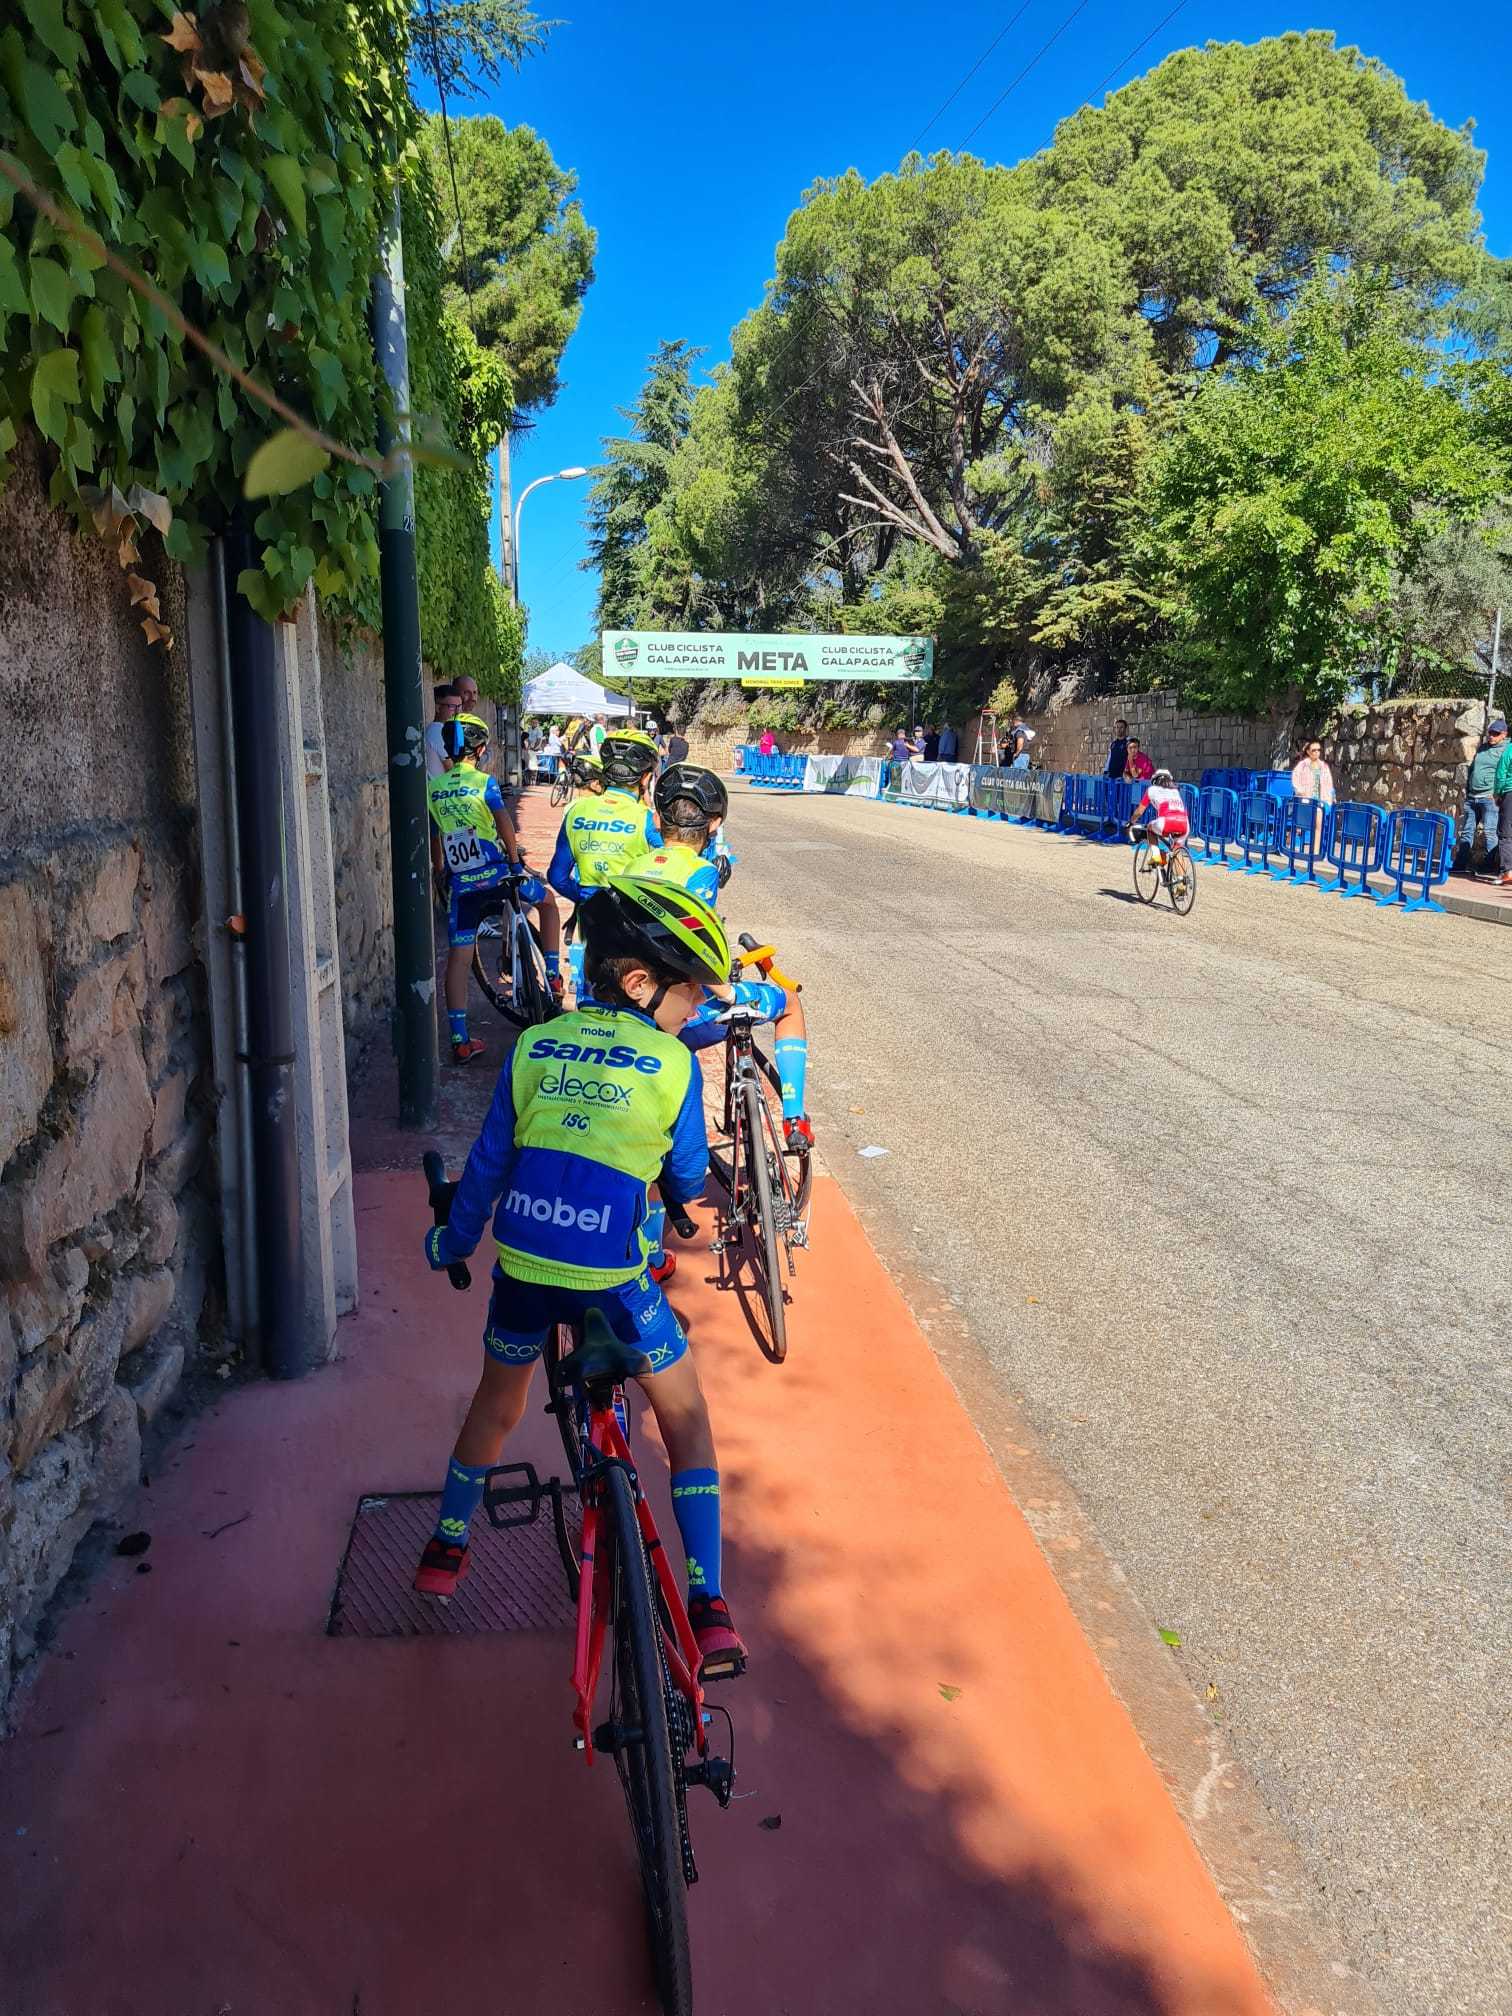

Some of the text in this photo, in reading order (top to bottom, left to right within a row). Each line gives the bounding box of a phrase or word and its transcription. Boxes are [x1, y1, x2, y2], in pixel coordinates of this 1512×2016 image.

[647, 643, 724, 653] CLUB CICLISTA
[821, 646, 893, 655] CLUB CICLISTA
[647, 655, 725, 665] GALAPAGAR
[737, 651, 809, 671] META
[821, 657, 895, 667] GALAPAGAR
[572, 816, 637, 834] SanSe
[448, 838, 481, 866] 304
[580, 1026, 616, 1039] mobel
[528, 1038, 663, 1075] SanSe
[539, 1063, 635, 1106] elecox
[561, 1112, 590, 1131] ISC
[505, 1188, 612, 1234] mobel
[640, 1304, 658, 1326] ISC
